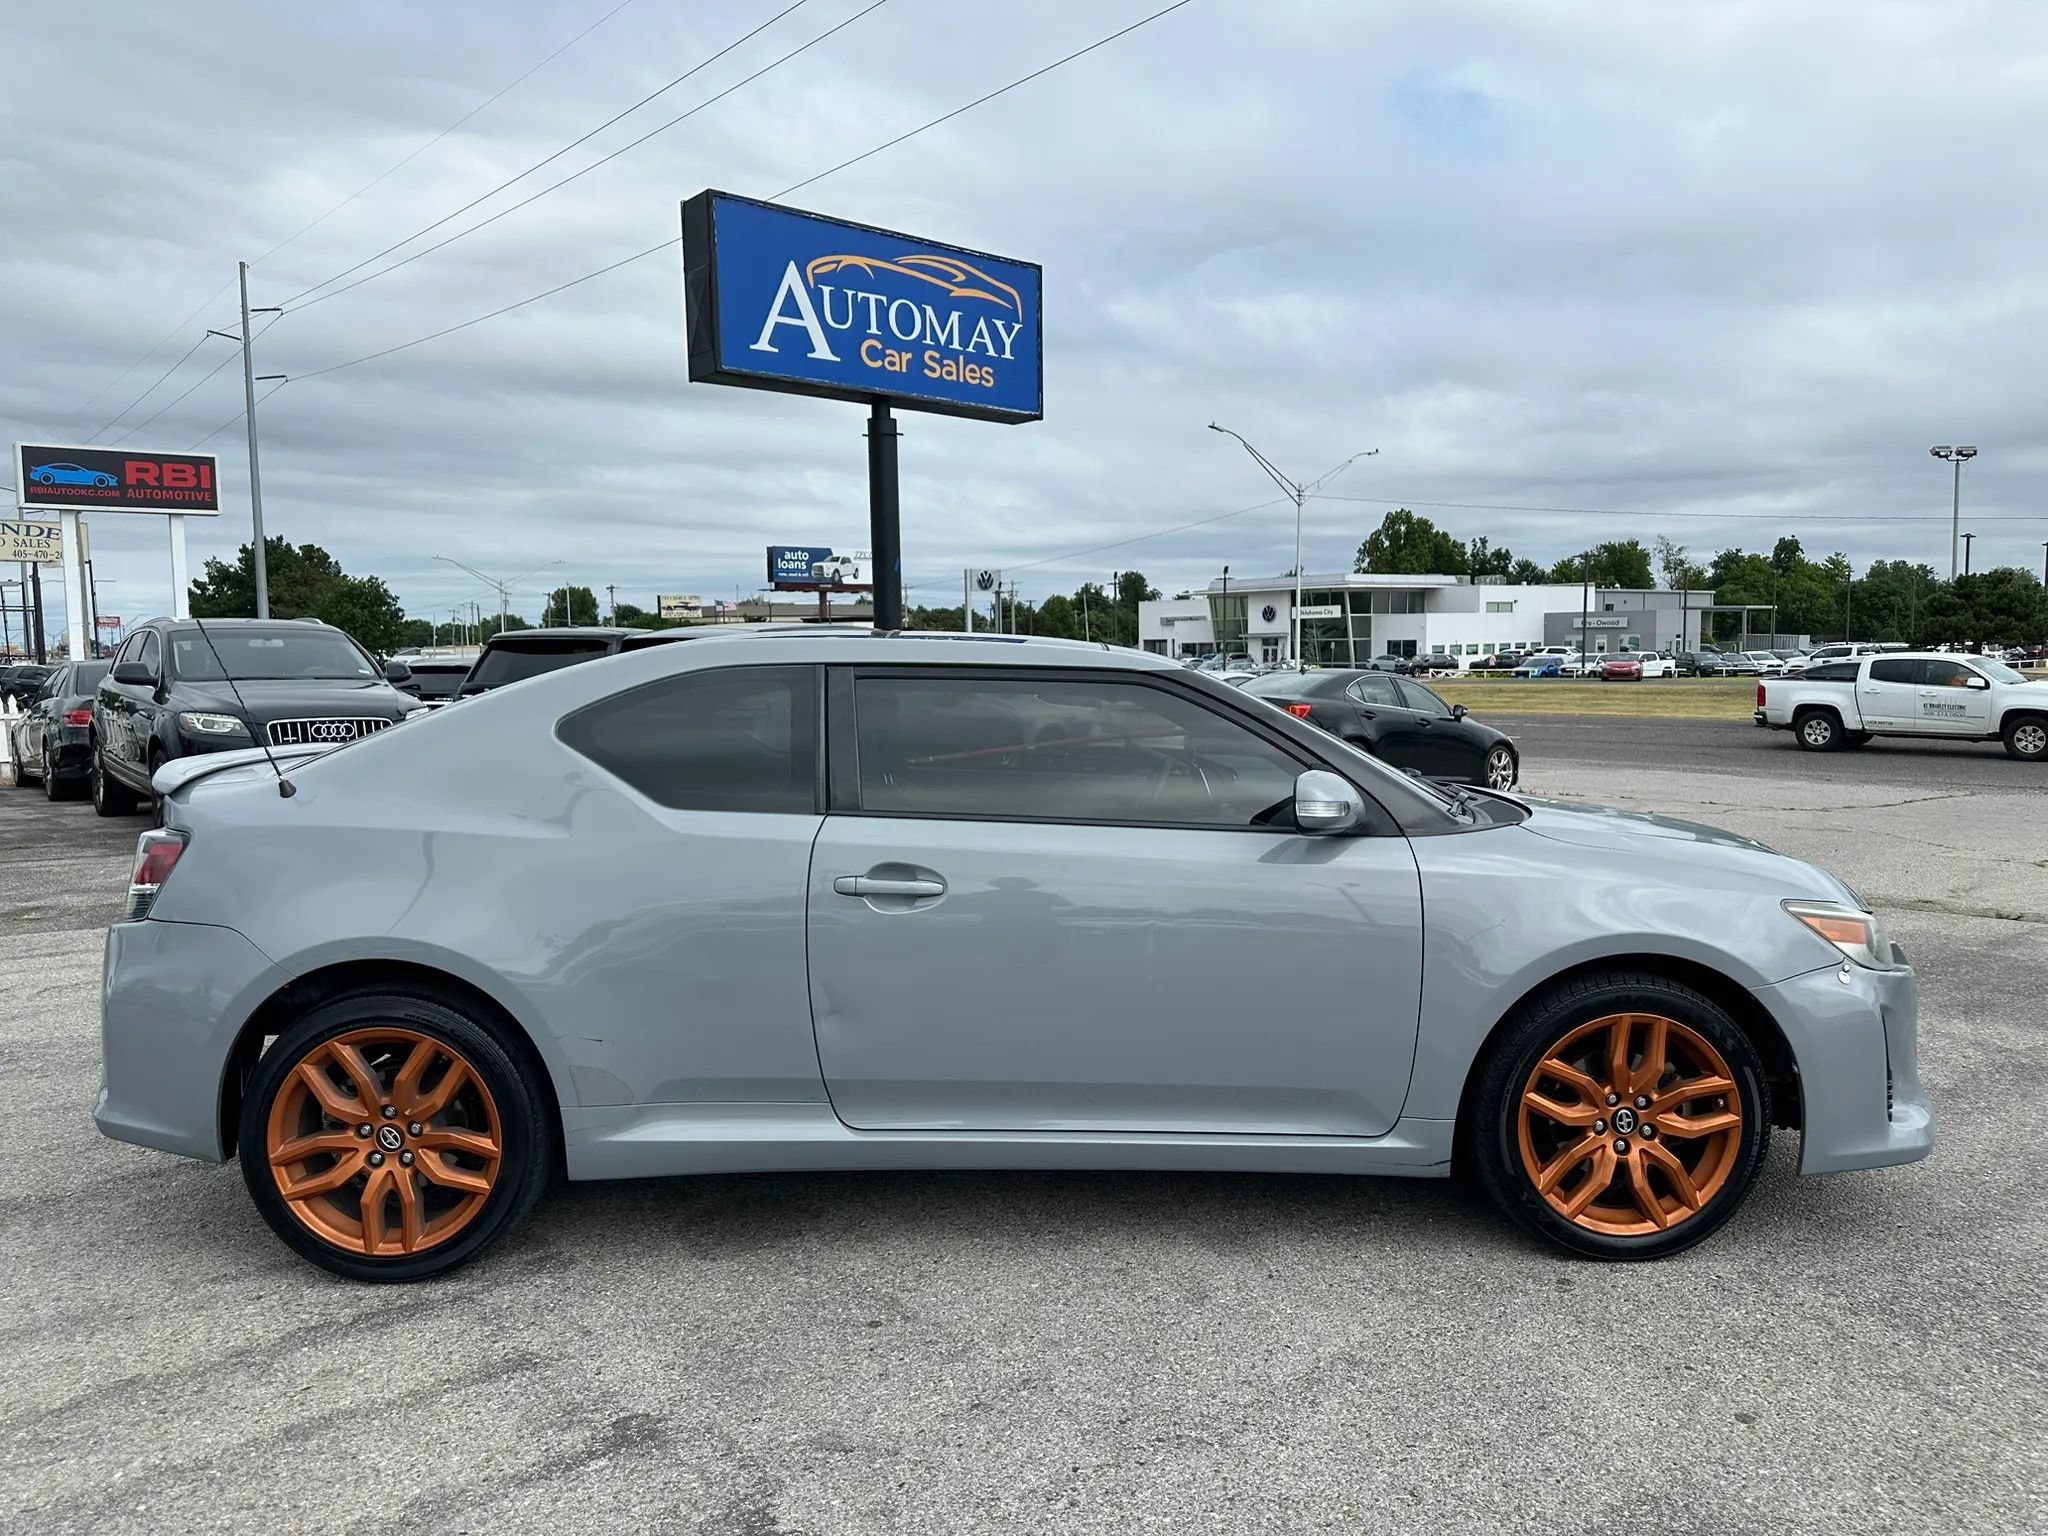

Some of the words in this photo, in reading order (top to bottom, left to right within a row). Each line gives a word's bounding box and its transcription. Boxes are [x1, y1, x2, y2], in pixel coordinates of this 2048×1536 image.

[750, 260, 1023, 362] AUTOMAY
[860, 339, 912, 373] Car
[924, 350, 994, 387] Sales
[125, 460, 212, 489] RBI
[30, 487, 120, 498] RBIAUTOOKC.COM
[127, 489, 212, 502] AUTOMOTIVE
[13, 538, 51, 549] SALES
[784, 551, 810, 560] auto
[777, 558, 807, 569] loans
